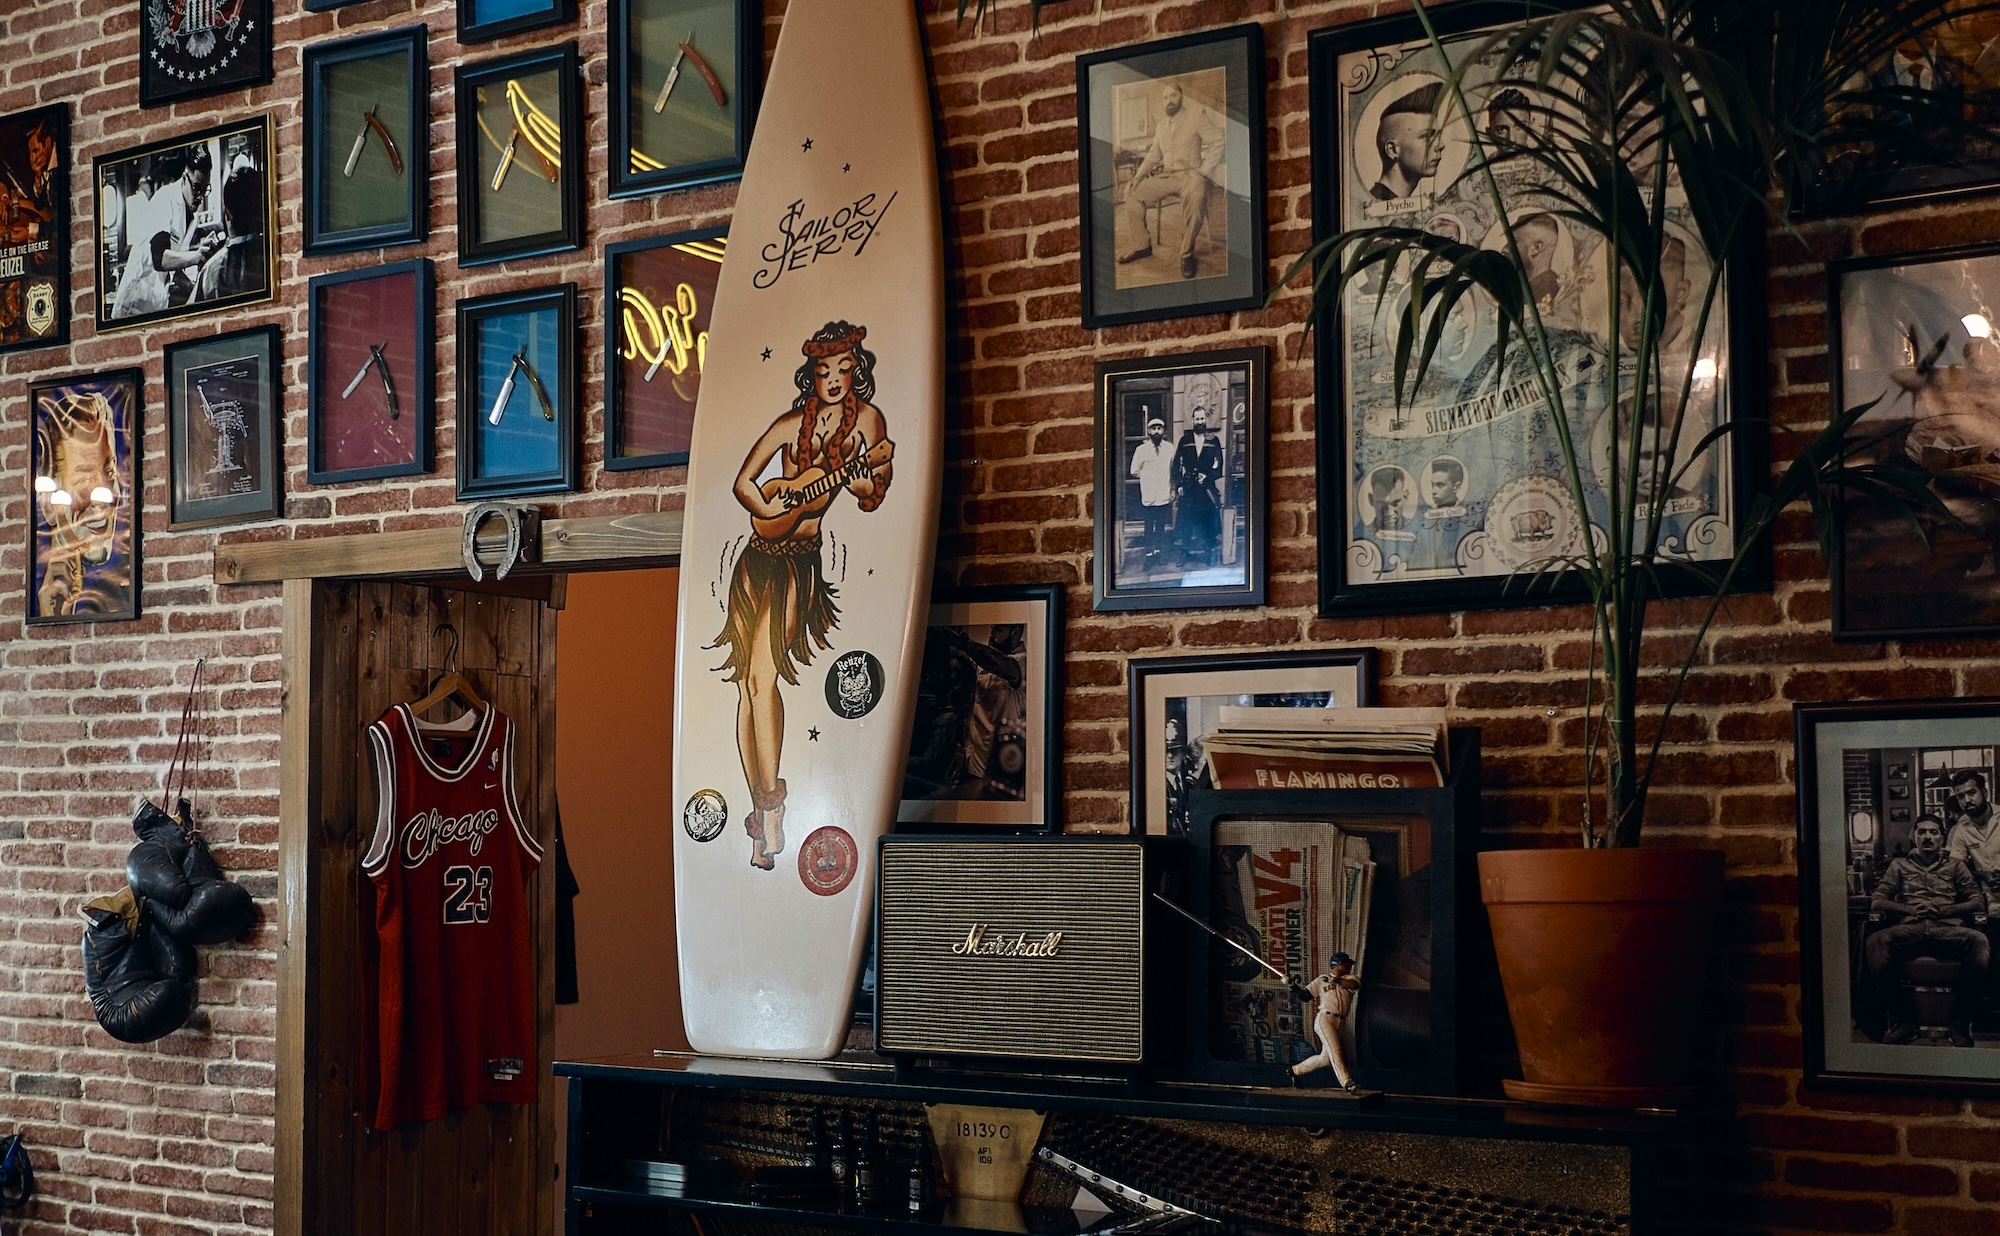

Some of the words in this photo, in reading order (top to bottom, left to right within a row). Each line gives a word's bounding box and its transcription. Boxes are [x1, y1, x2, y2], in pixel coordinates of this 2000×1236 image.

[1385, 200, 1415, 212] Psycho
[753, 191, 898, 289] JERRY
[762, 193, 877, 262] SAILOR
[9, 247, 17, 257] ON
[17, 244, 27, 255] THE
[28, 240, 49, 253] GREASE
[1425, 395, 1500, 434] SIGNATURE
[1670, 499, 1695, 512] Fade
[1255, 769, 1400, 789] FLAMINGO
[399, 807, 498, 869] Chicago
[443, 865, 493, 925] 23
[1253, 847, 1302, 910] V4
[951, 923, 1062, 957] Marshall
